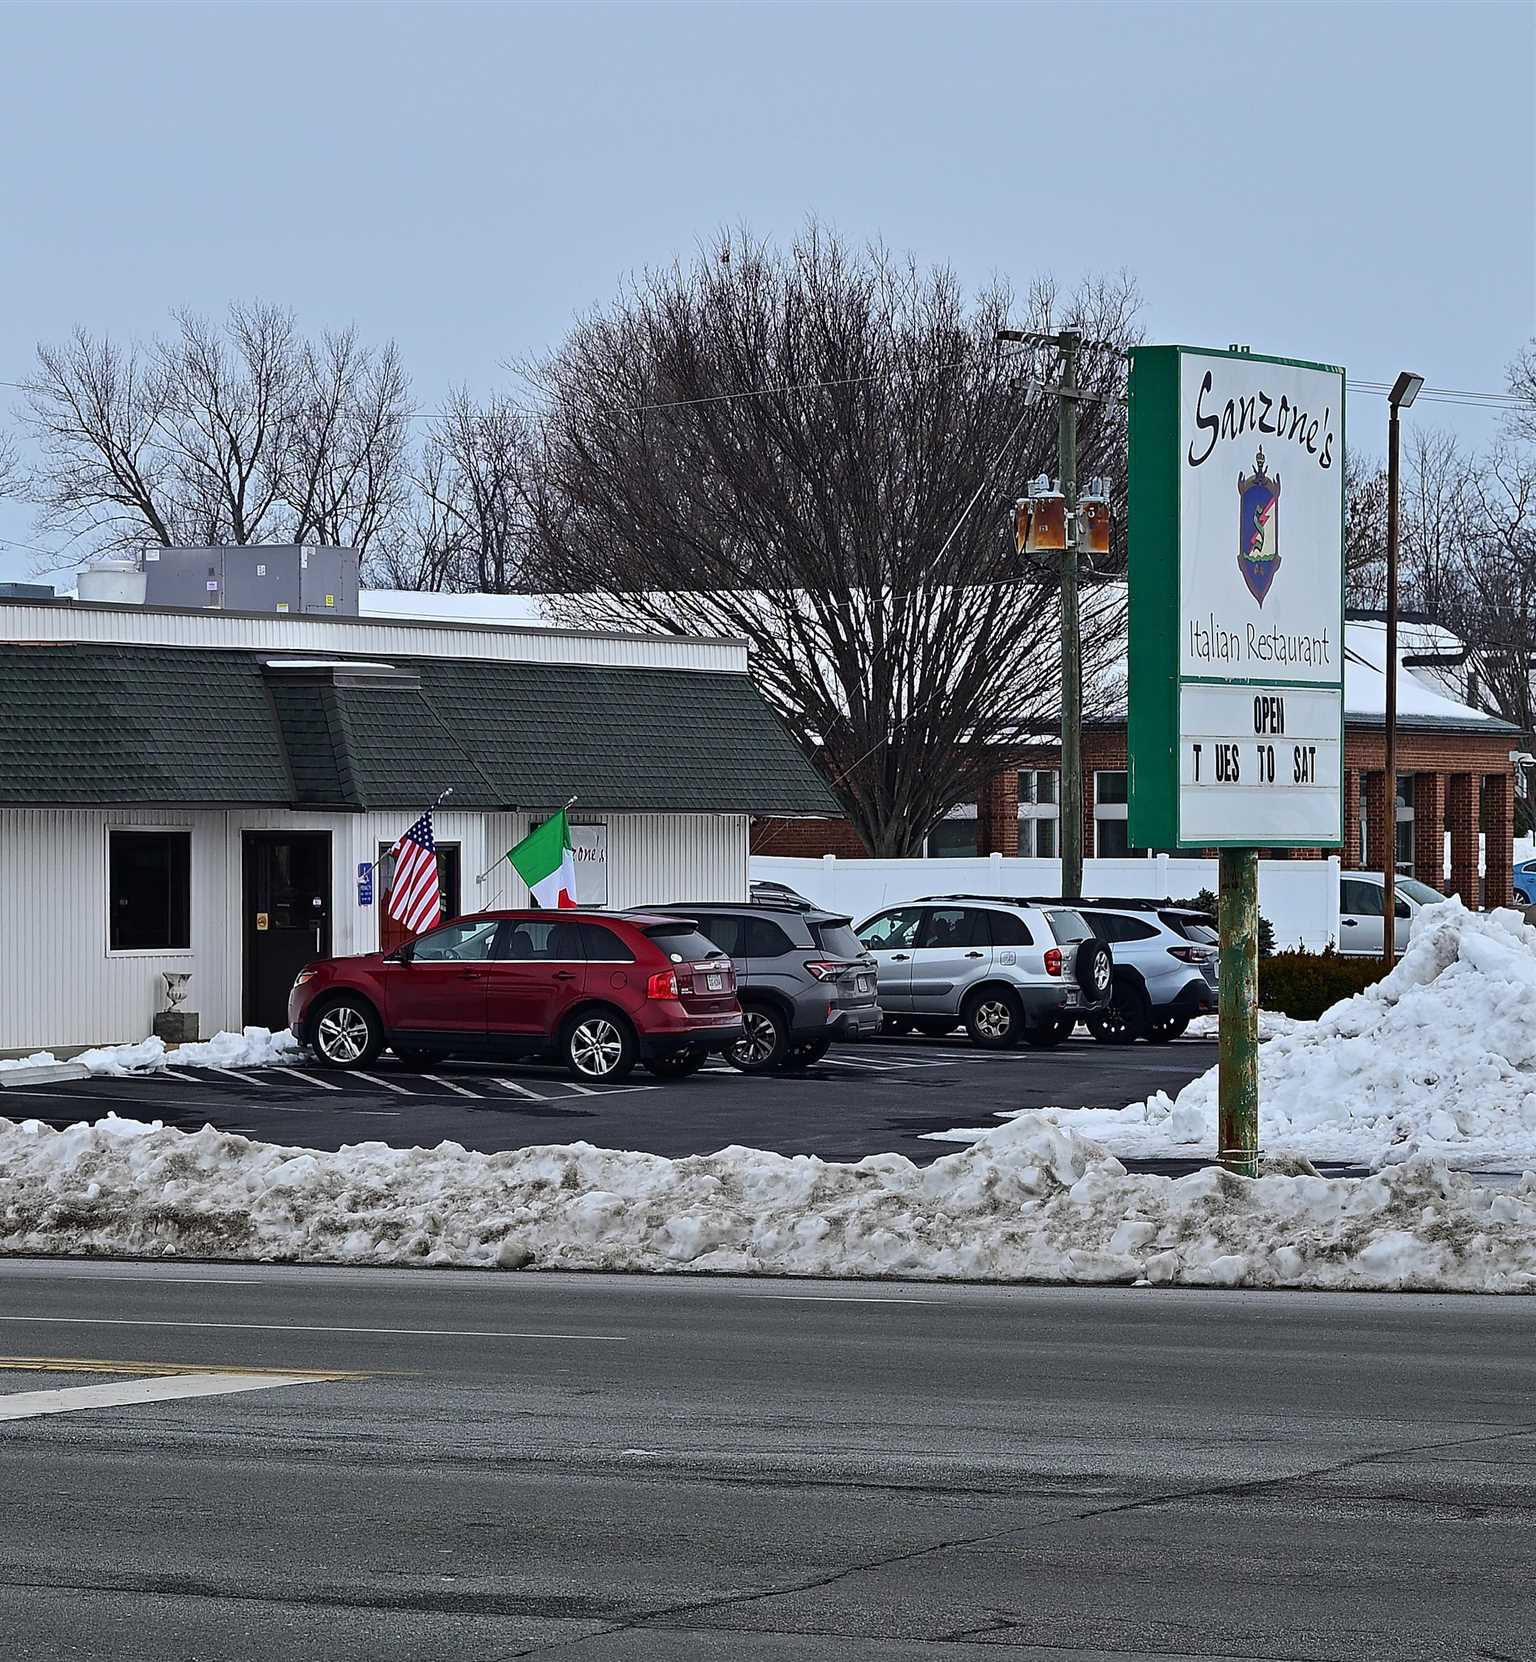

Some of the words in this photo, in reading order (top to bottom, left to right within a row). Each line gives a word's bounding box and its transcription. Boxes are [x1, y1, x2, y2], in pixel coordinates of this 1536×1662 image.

[1188, 369, 1333, 469] Sanzone's
[1189, 613, 1240, 661] Italian
[1246, 623, 1330, 666] Restaurant
[1253, 695, 1285, 735] OPEN
[1257, 744, 1275, 783] TO
[1293, 744, 1316, 785] SAT
[572, 835, 605, 863] zone's
